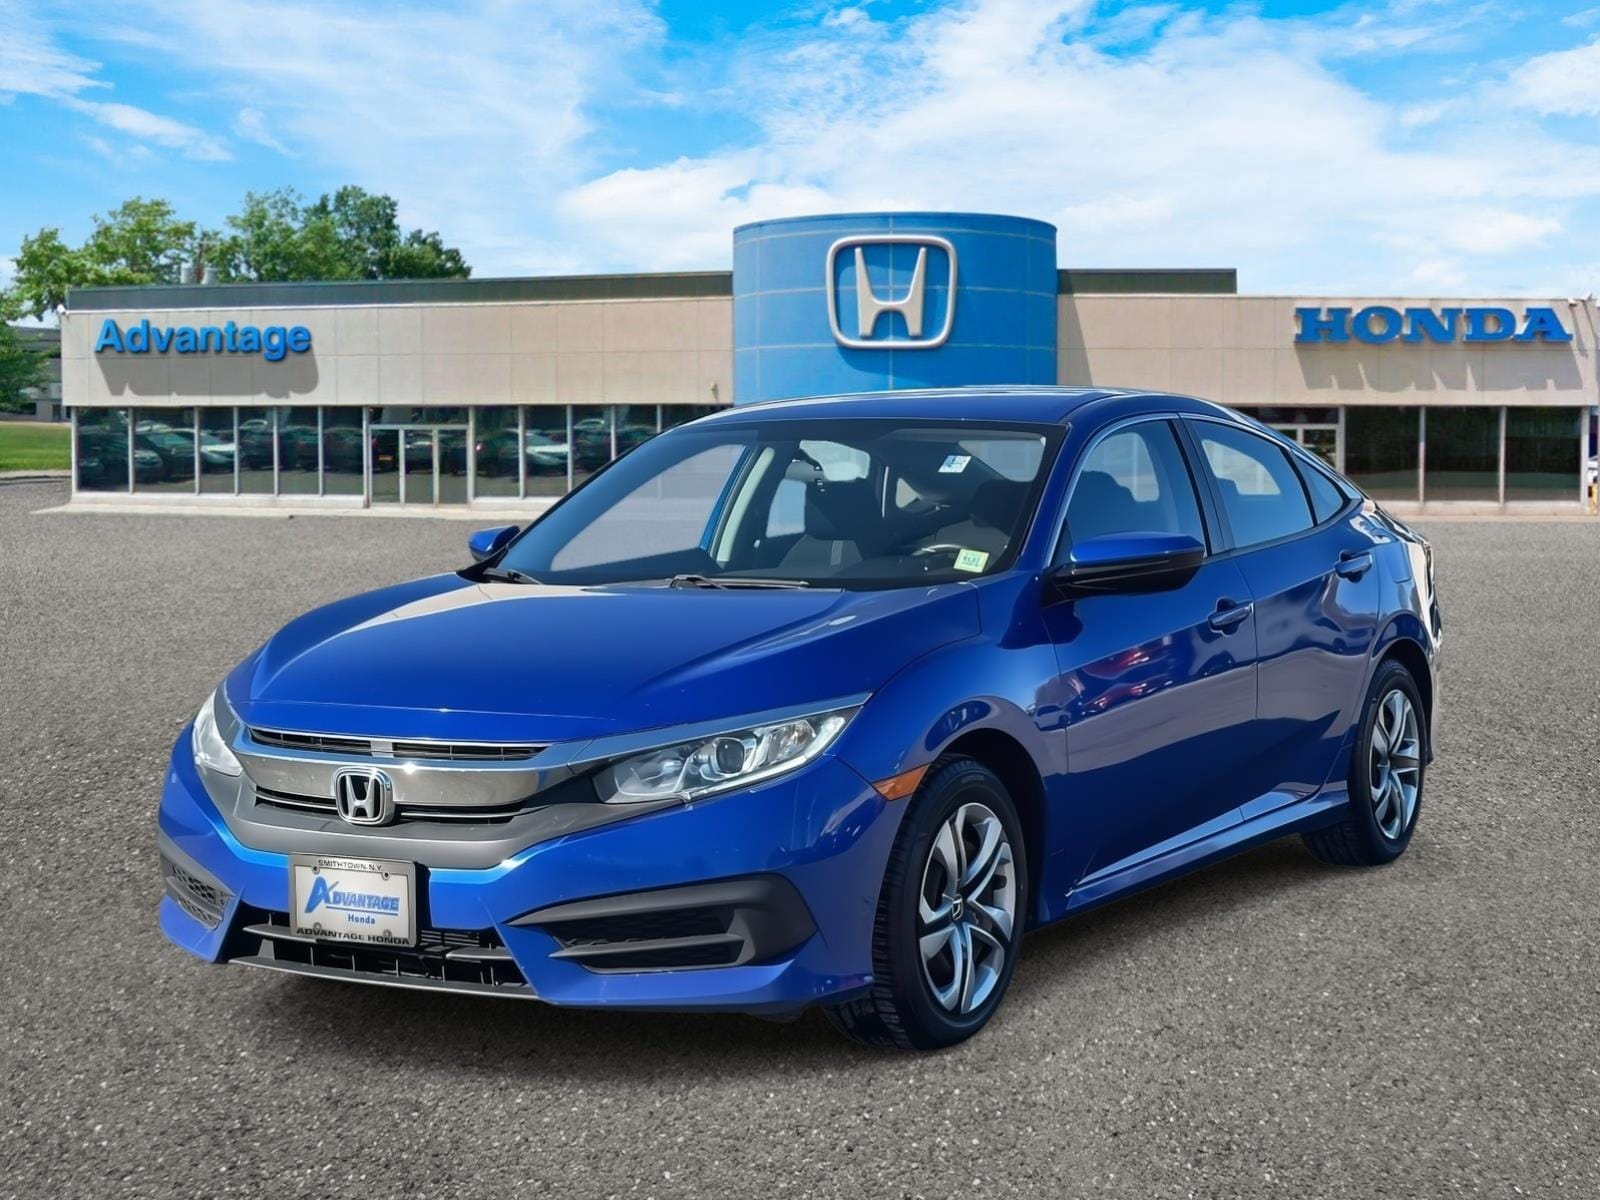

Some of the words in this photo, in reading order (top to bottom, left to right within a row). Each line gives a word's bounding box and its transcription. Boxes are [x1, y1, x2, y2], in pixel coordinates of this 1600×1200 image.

[95, 319, 312, 361] Advantage
[1295, 306, 1573, 344] HONDA
[304, 876, 400, 913] ADVANTAGE
[296, 927, 365, 940] ADVANTAGE
[367, 934, 410, 945] HONDA
[347, 913, 376, 925] Honda
